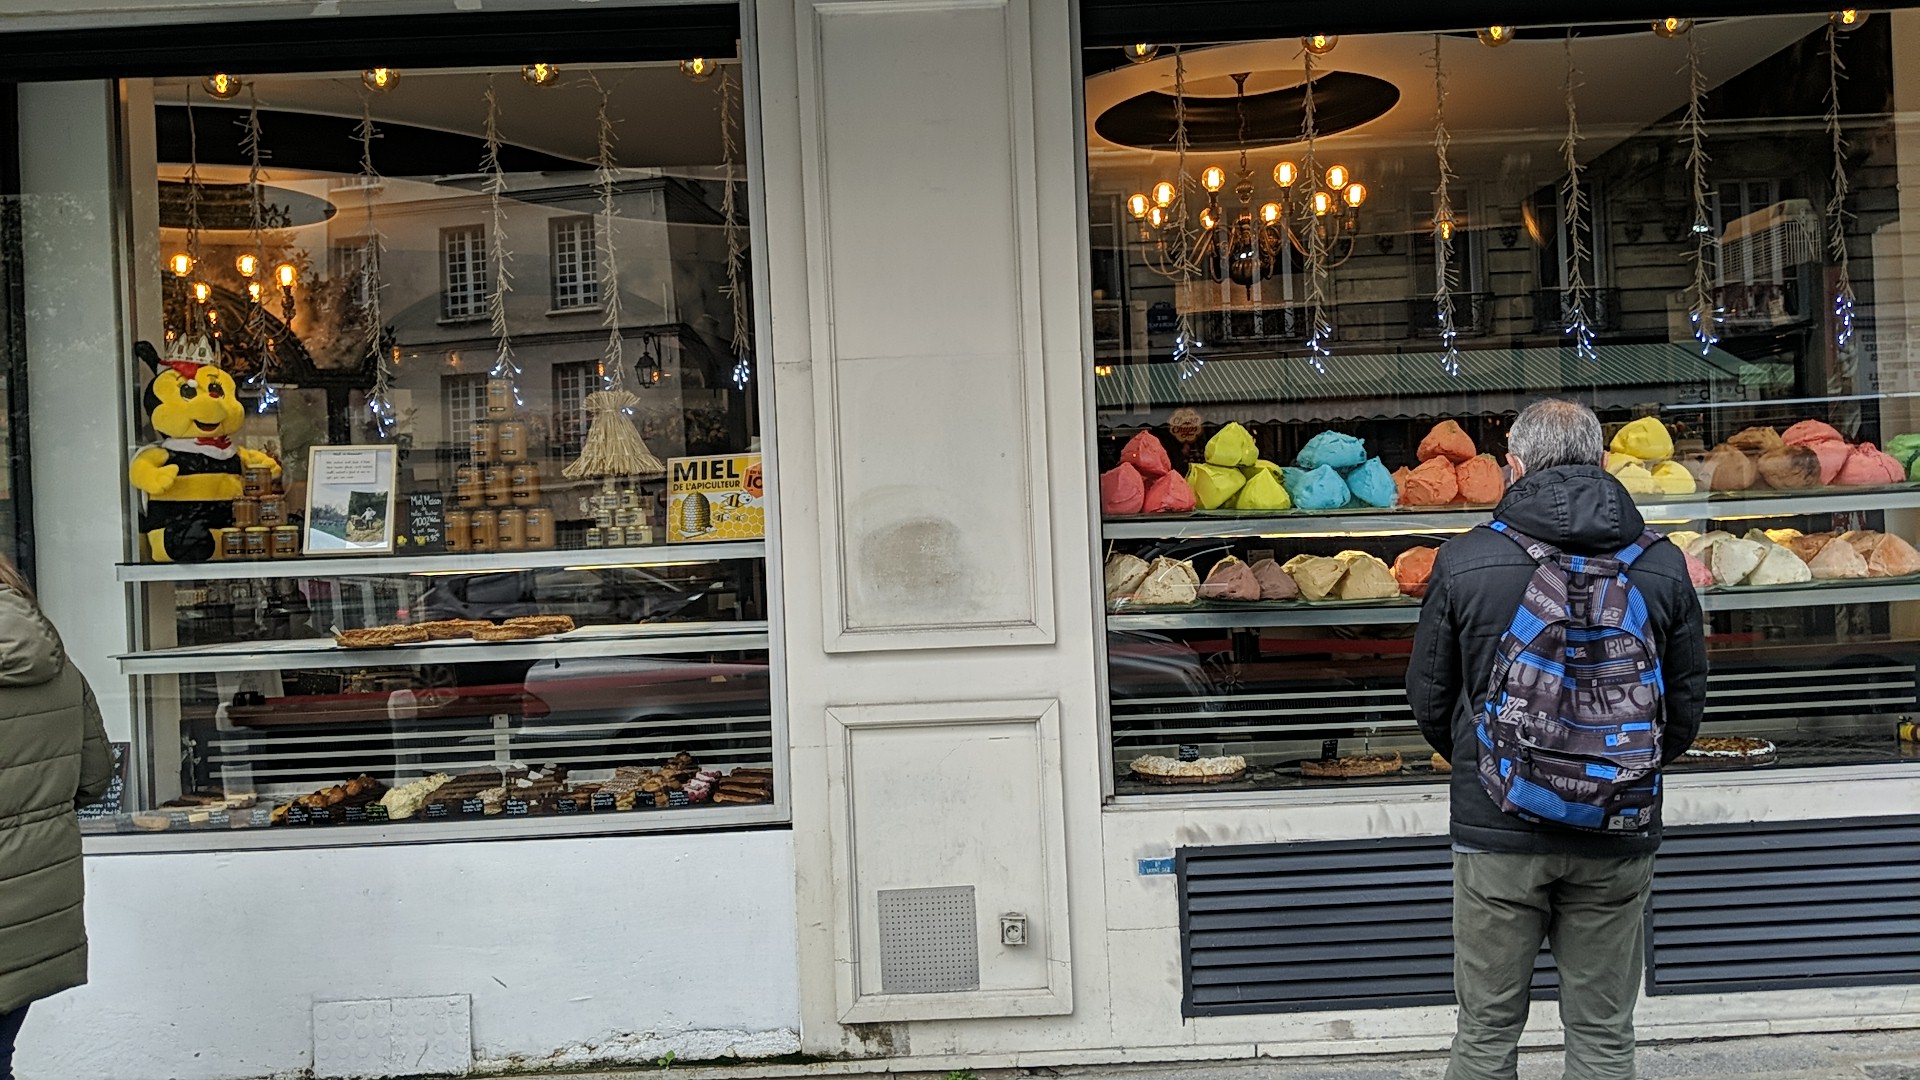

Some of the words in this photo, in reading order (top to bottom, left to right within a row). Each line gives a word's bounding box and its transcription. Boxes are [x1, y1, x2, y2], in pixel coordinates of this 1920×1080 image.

[673, 460, 740, 482] MIEL
[673, 483, 684, 491] DE
[685, 480, 741, 490] L'APICULTEUR
